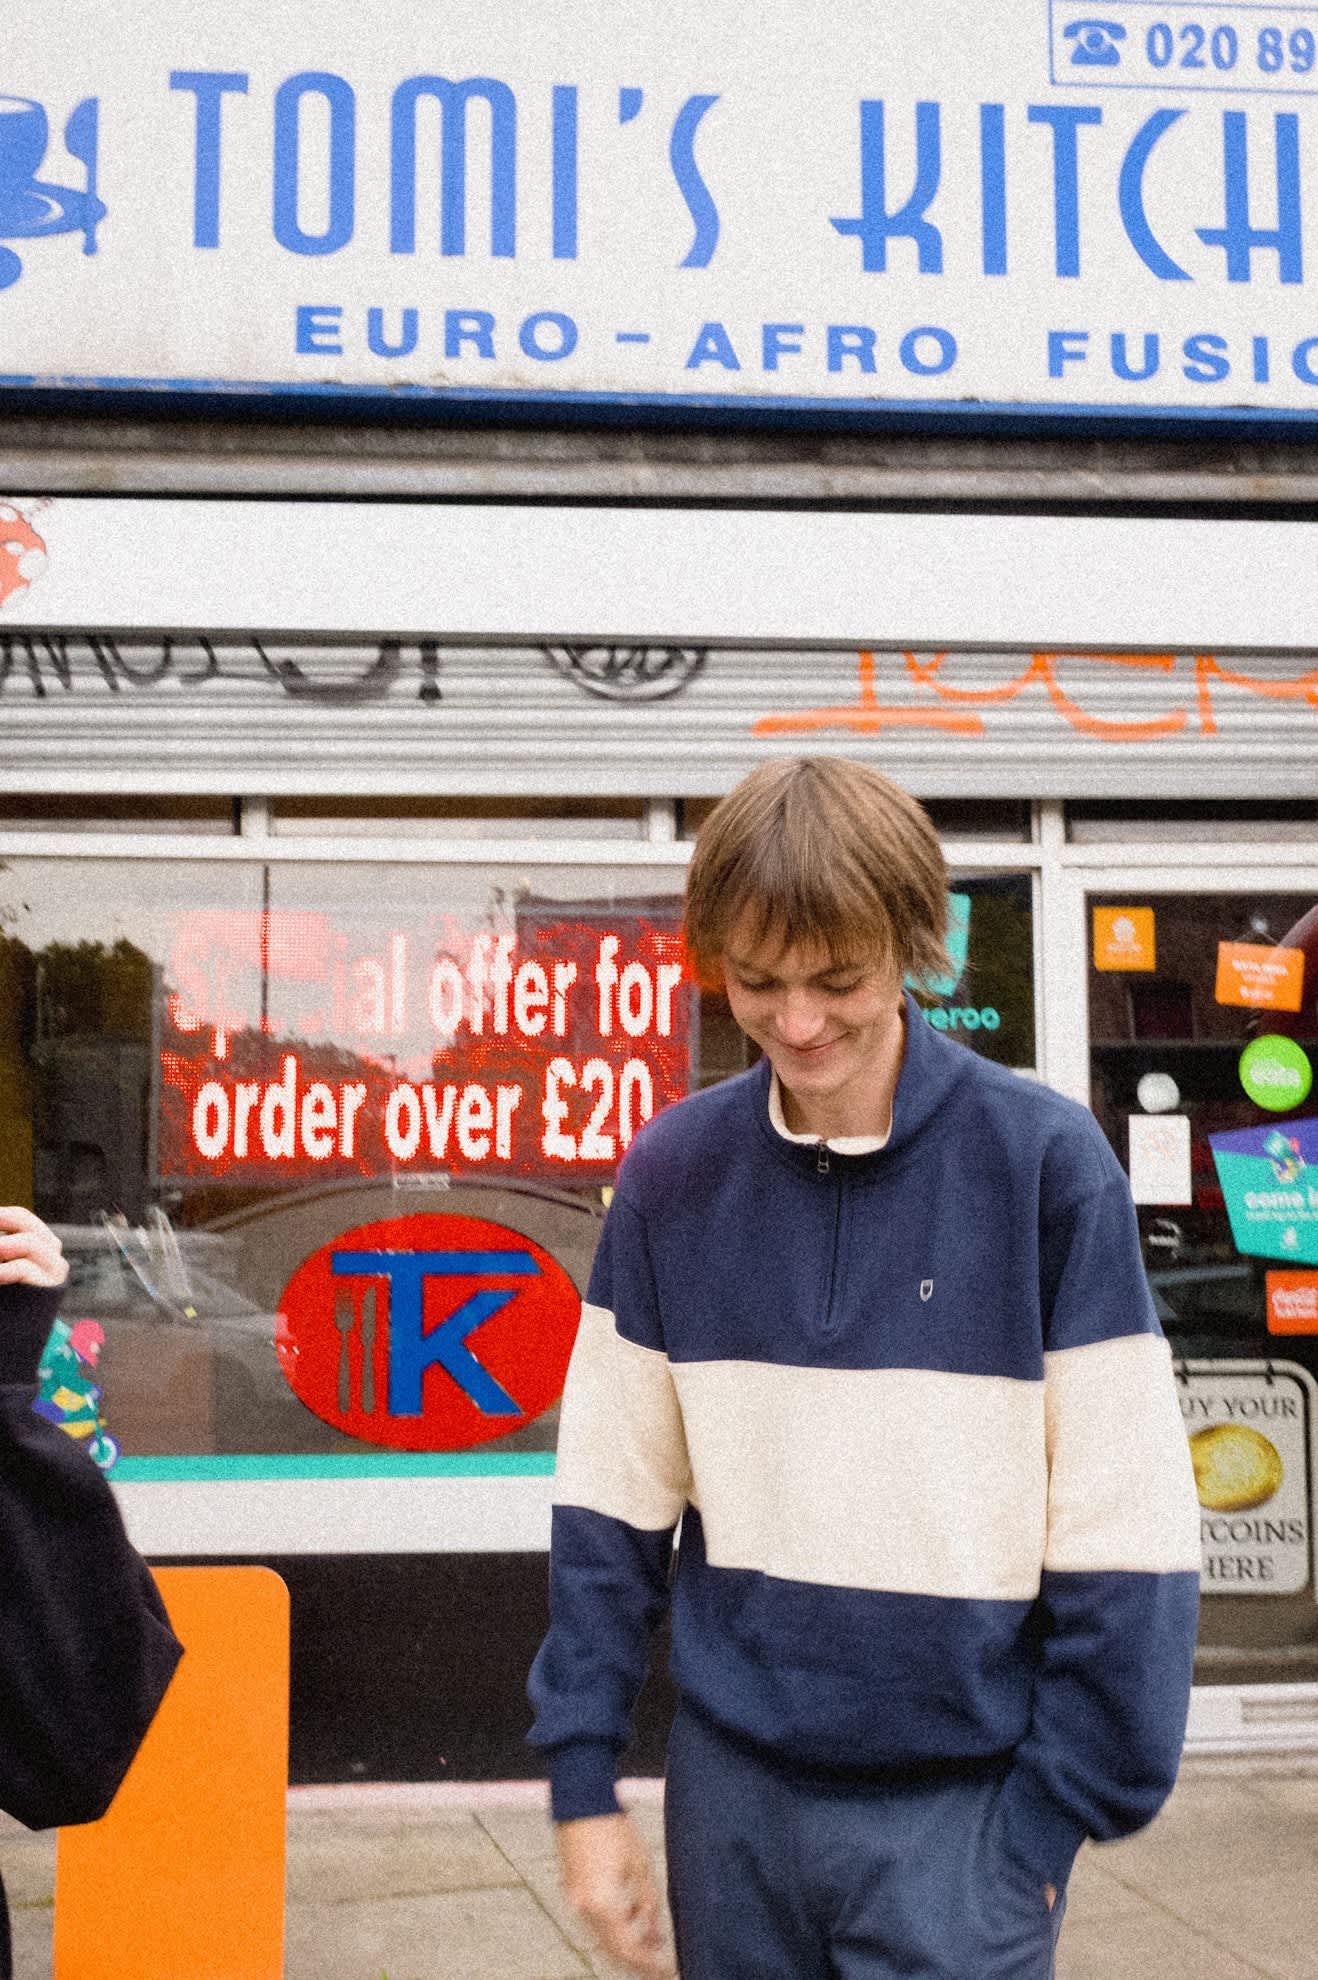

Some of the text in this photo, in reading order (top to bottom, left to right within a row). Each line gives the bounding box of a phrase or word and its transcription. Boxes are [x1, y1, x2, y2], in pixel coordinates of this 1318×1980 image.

[1145, 21, 1316, 74] 020 89
[169, 70, 1305, 286] TOMI'S KITCH
[170, 928, 683, 1061] Spial offer for
[192, 1055, 655, 1162] order over £20
[1179, 1396, 1300, 1419] UY YOUR
[1200, 1517, 1306, 1545] TCOINS
